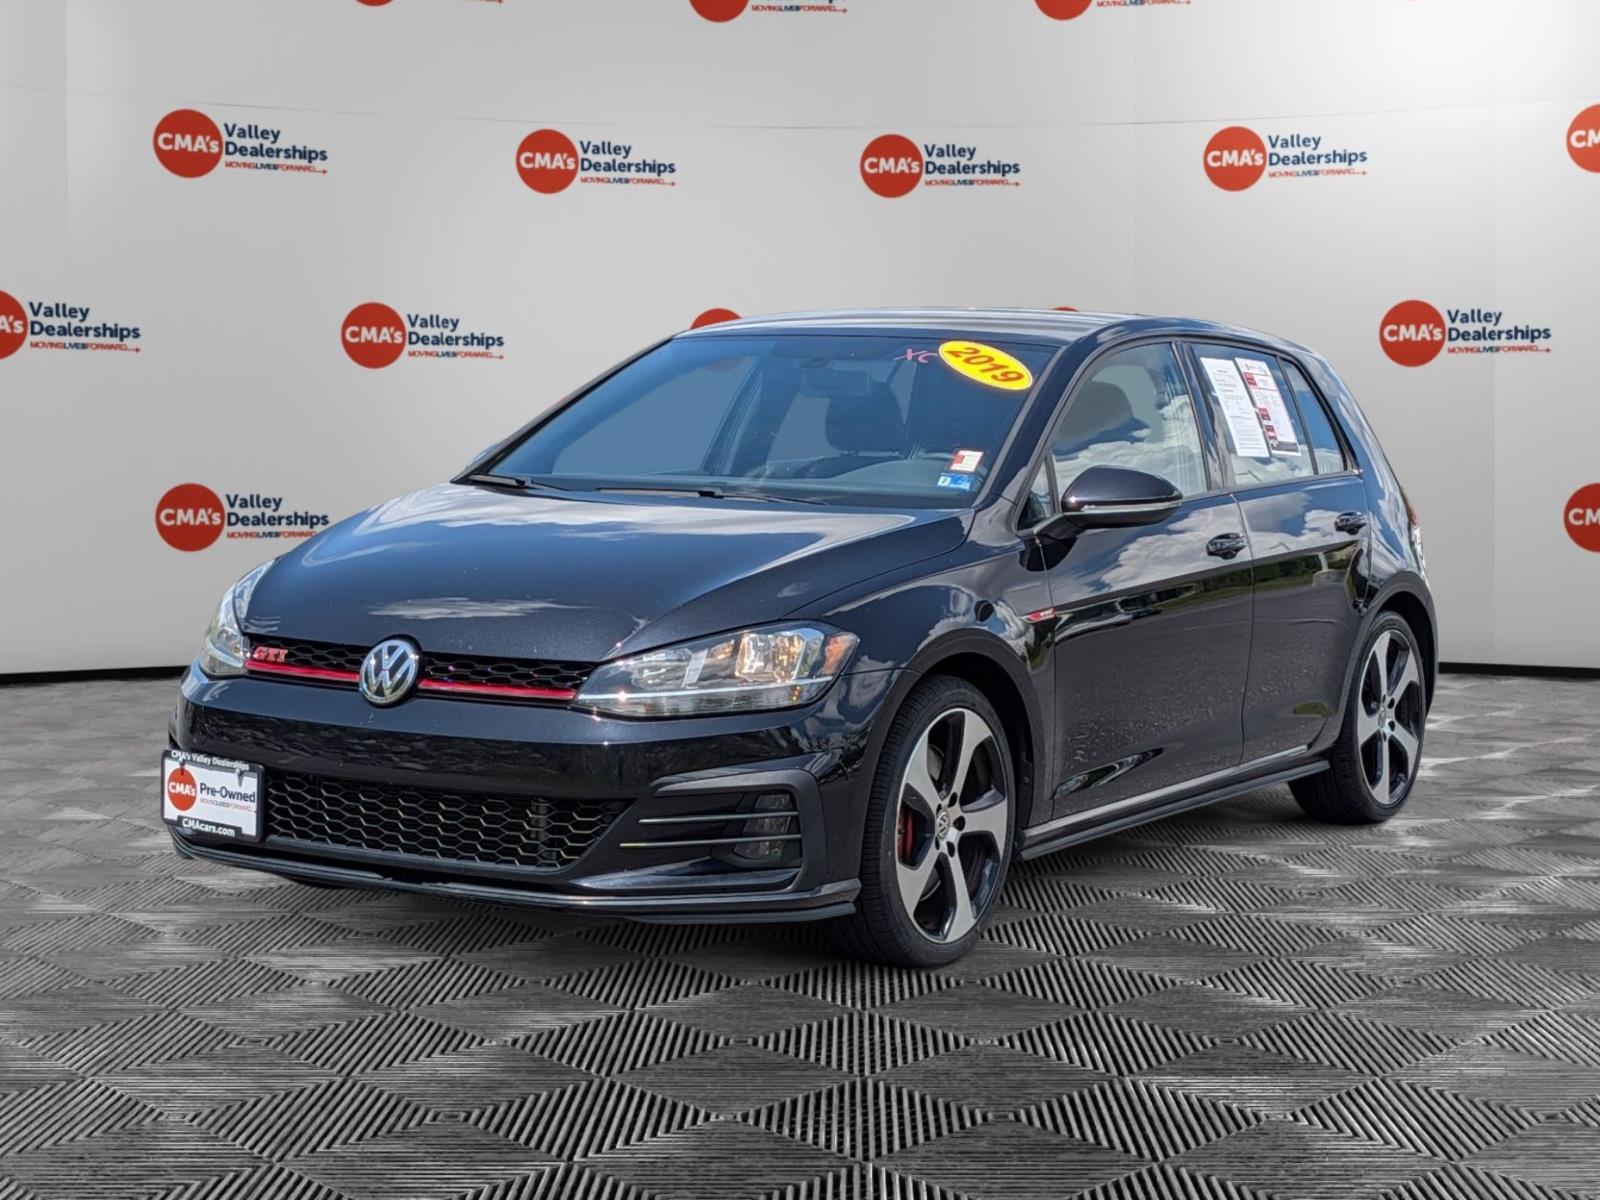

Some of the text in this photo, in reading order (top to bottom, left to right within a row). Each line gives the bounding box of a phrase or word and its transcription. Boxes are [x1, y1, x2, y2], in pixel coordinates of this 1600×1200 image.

[224, 123, 280, 143] Valley
[157, 132, 219, 153] CMA's
[579, 140, 632, 159] Valley
[1268, 134, 1321, 151] Valley
[225, 141, 328, 163] Dealerships
[519, 152, 576, 170] CMA's
[924, 144, 976, 160] Valley
[1207, 149, 1264, 168] CMA's
[1268, 149, 1368, 167] Dealerships
[580, 157, 676, 176] Dealerships
[864, 156, 920, 174] CMA's
[925, 160, 1020, 177] Dealerships
[29, 301, 90, 323] Valley
[1447, 309, 1503, 326] Valley
[30, 320, 141, 342] Dealerships
[407, 314, 460, 332] Valley
[345, 325, 404, 344] CMA's
[408, 331, 505, 350] Dealerships
[1383, 324, 1443, 342] CMA's
[1448, 325, 1552, 343] Dealerships
[944, 346, 1025, 382] 2019
[226, 494, 282, 512] Valley
[160, 508, 222, 527] CMA's
[227, 511, 330, 529] Dealerships
[254, 646, 289, 663] GTI
[192, 753, 211, 765] Valley
[169, 782, 195, 797] CMA's
[200, 782, 256, 803] Pre-Owned
[182, 818, 235, 837] CMAcars.com
